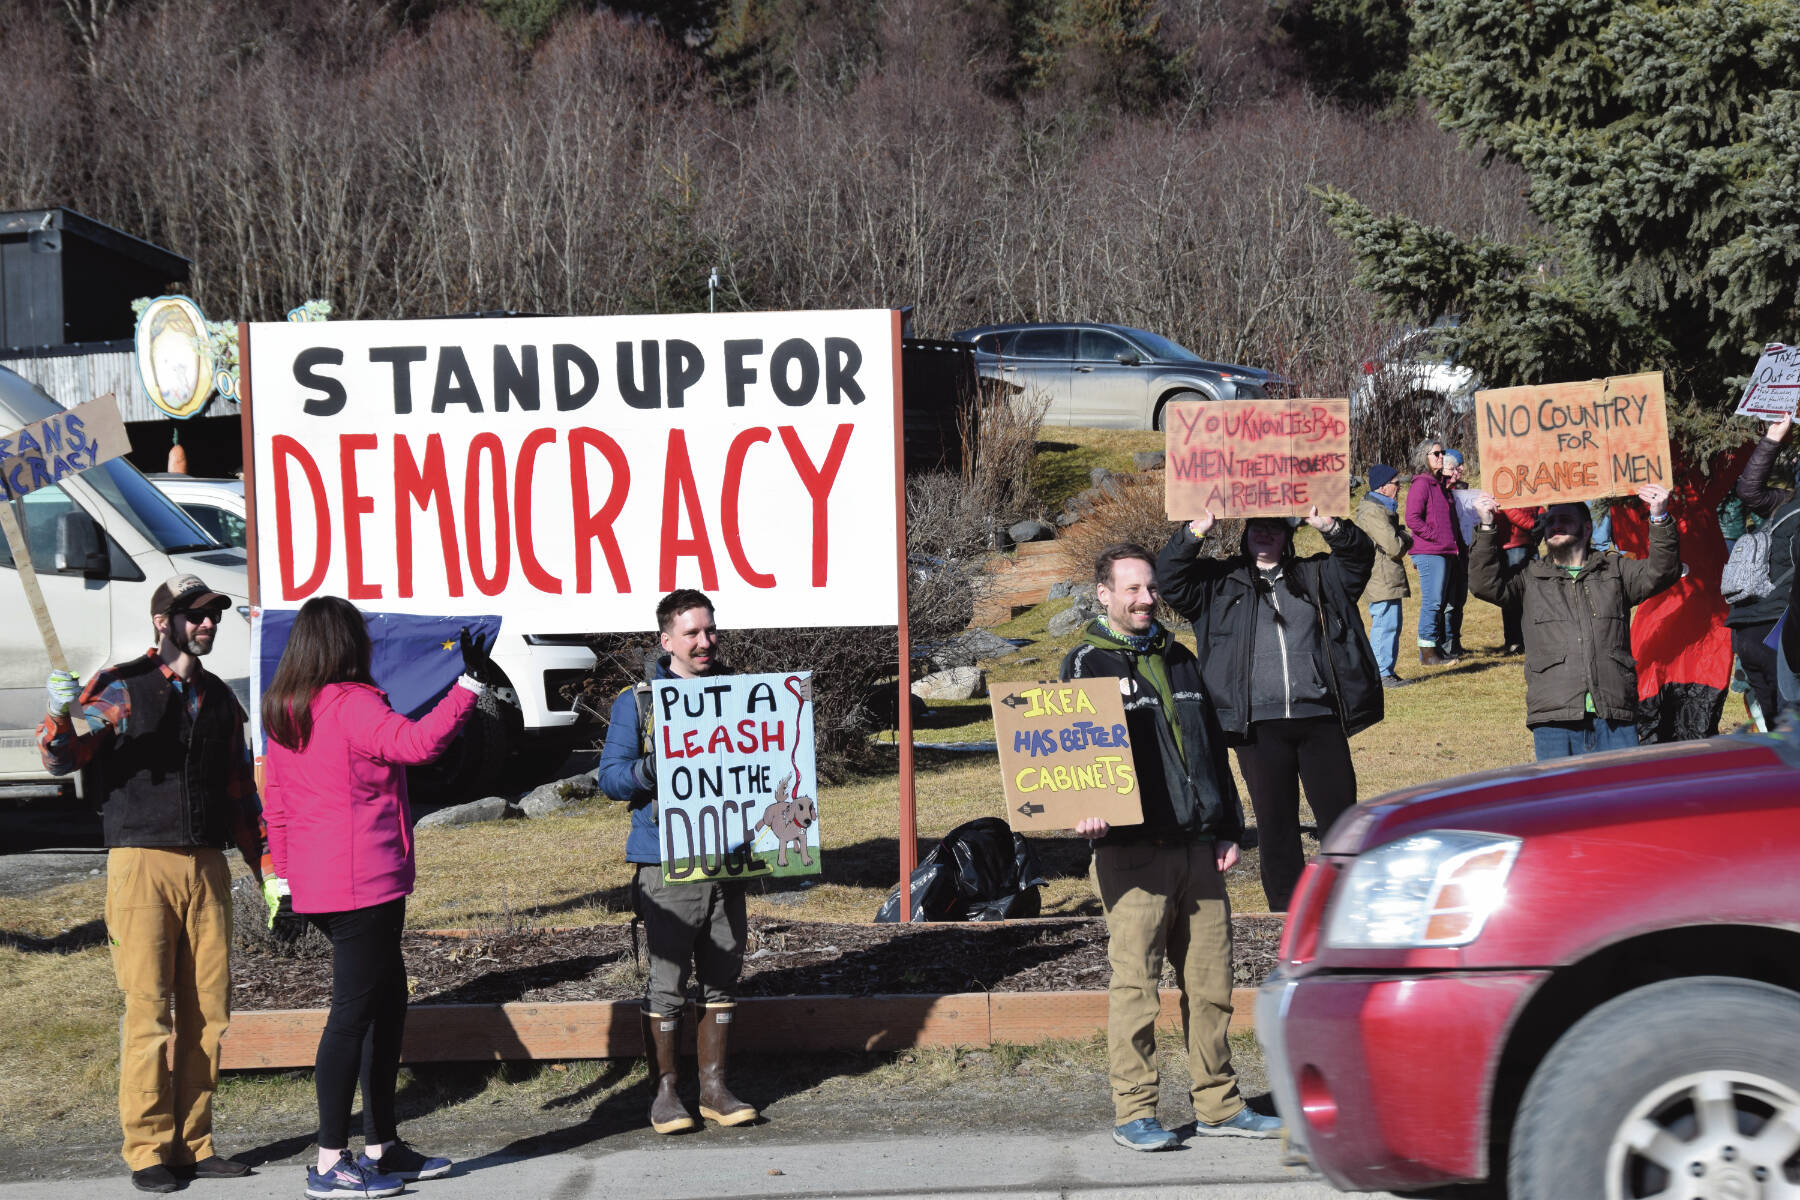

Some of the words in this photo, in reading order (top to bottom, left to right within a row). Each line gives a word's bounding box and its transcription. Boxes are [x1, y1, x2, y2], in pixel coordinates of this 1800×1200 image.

[293, 344, 599, 417] STAND
[616, 339, 705, 410] UP
[723, 337, 866, 408] FOR
[1175, 406, 1241, 446] YOU
[1240, 405, 1286, 442] KNOW
[1305, 406, 1347, 443] BAD
[1486, 402, 1531, 437] NO
[1537, 394, 1648, 432] COUNTRY
[1557, 431, 1599, 452] FOR
[0, 438, 99, 499] CRACY
[1170, 447, 1235, 481] WHEN
[1236, 458, 1262, 478] THE
[1256, 453, 1346, 477] INTROVERTS
[1492, 462, 1599, 500] ORANGE
[1613, 453, 1663, 484] MEN
[271, 423, 855, 602] DEMOCRACY
[1204, 482, 1257, 512] ARE
[1257, 479, 1310, 509] HERE
[660, 684, 732, 721] PUT
[747, 682, 777, 714] A
[1020, 687, 1097, 718] IKEA
[663, 719, 785, 760] LEASH
[1013, 728, 1058, 758] HAS
[1059, 721, 1130, 753] BETTER
[671, 765, 723, 801] ON
[728, 764, 772, 795] THE
[1015, 756, 1136, 796] CABINETS
[664, 799, 768, 880] DOGE
